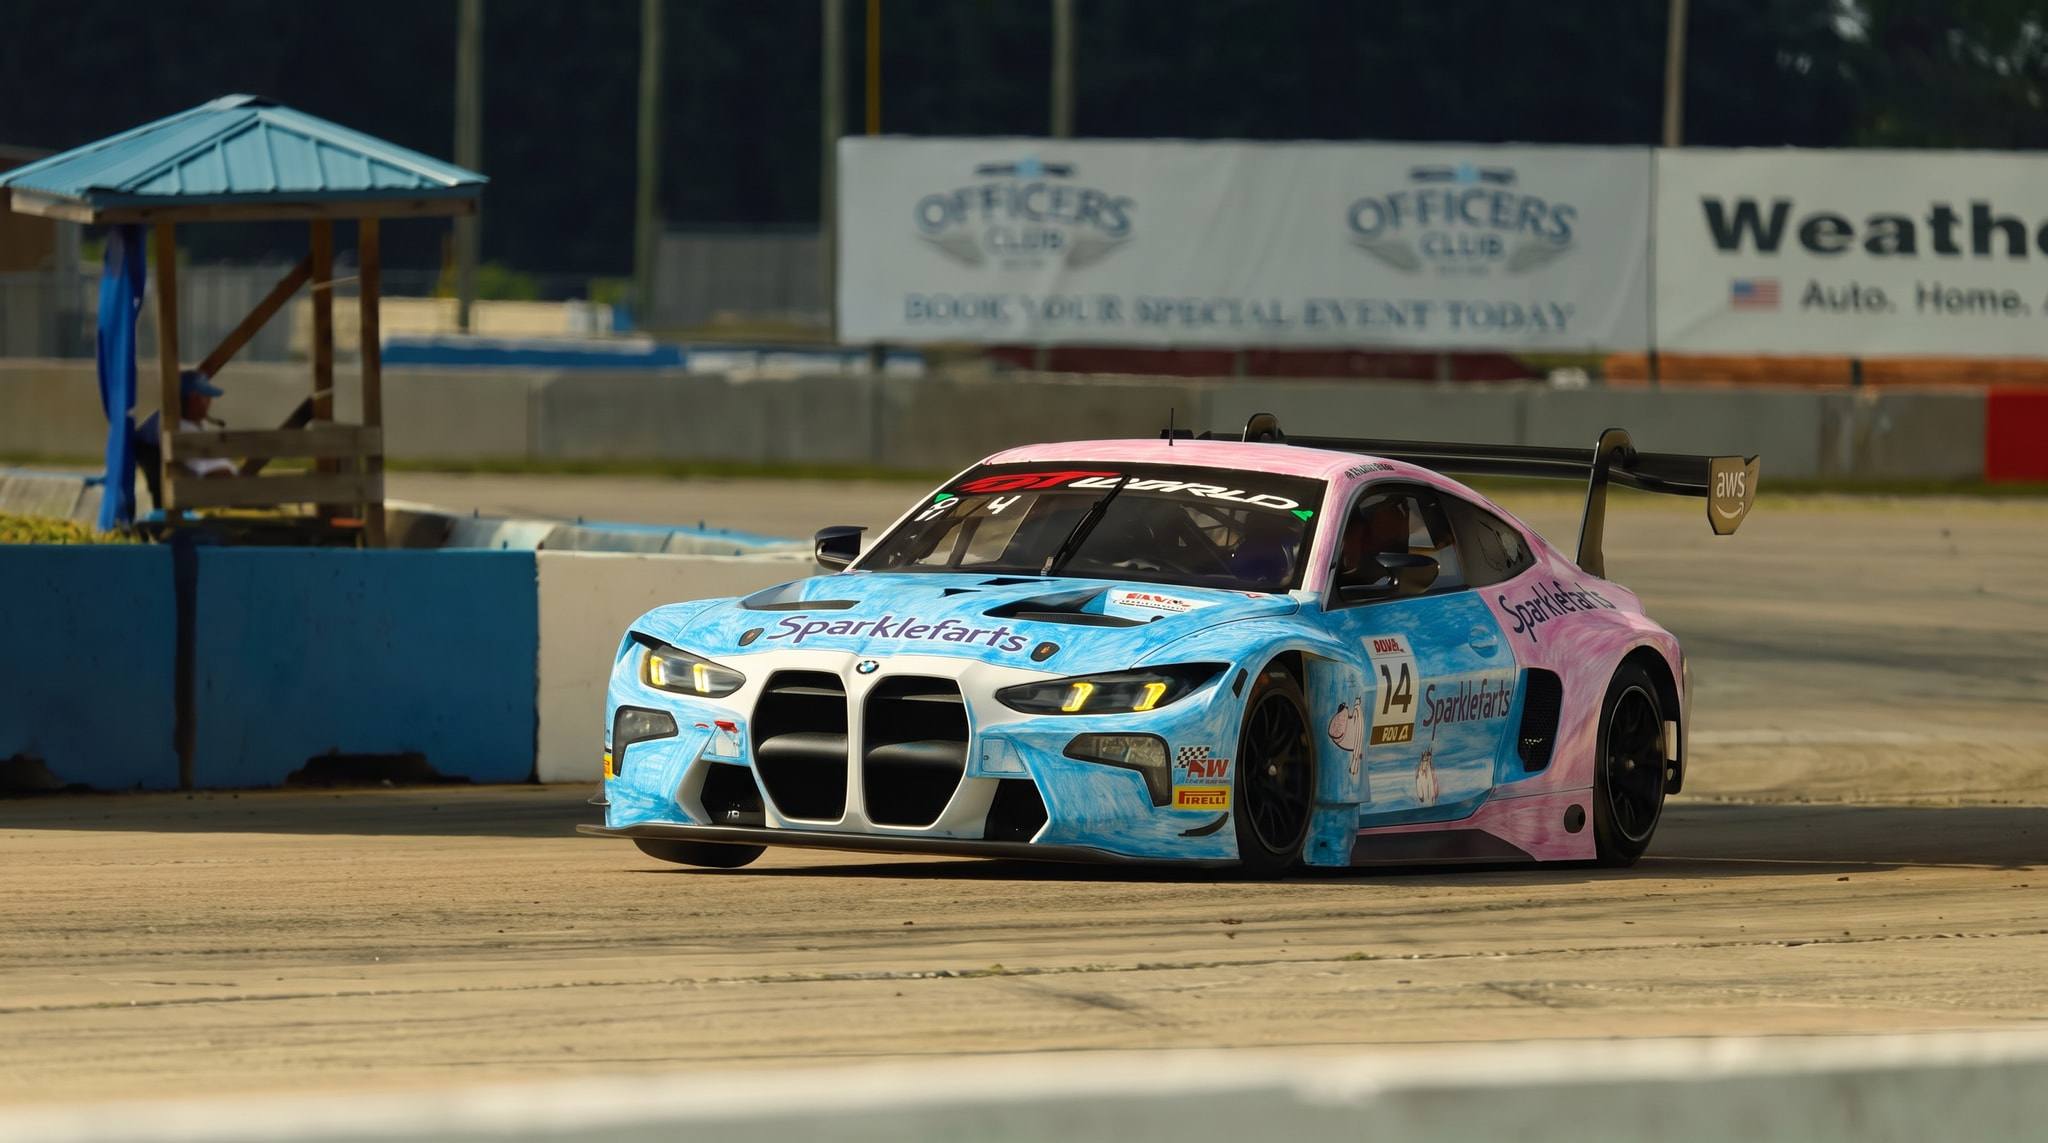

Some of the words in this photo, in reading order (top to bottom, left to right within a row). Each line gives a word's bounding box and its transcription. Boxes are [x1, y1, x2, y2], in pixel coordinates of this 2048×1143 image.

[914, 183, 1137, 236] OFFICERS
[1349, 188, 1577, 245] OFFICERS
[1701, 198, 2047, 257] Weath
[1304, 299, 1434, 330] EVENT
[1448, 301, 1576, 333] TODAY
[1716, 471, 1746, 498] aws
[766, 615, 1028, 652] Sparklefarts
[1498, 580, 1617, 643] Sparklefarts
[1380, 662, 1412, 715] 14
[1422, 678, 1511, 741] Sparklefarts
[1178, 790, 1227, 805] PIRELLI
